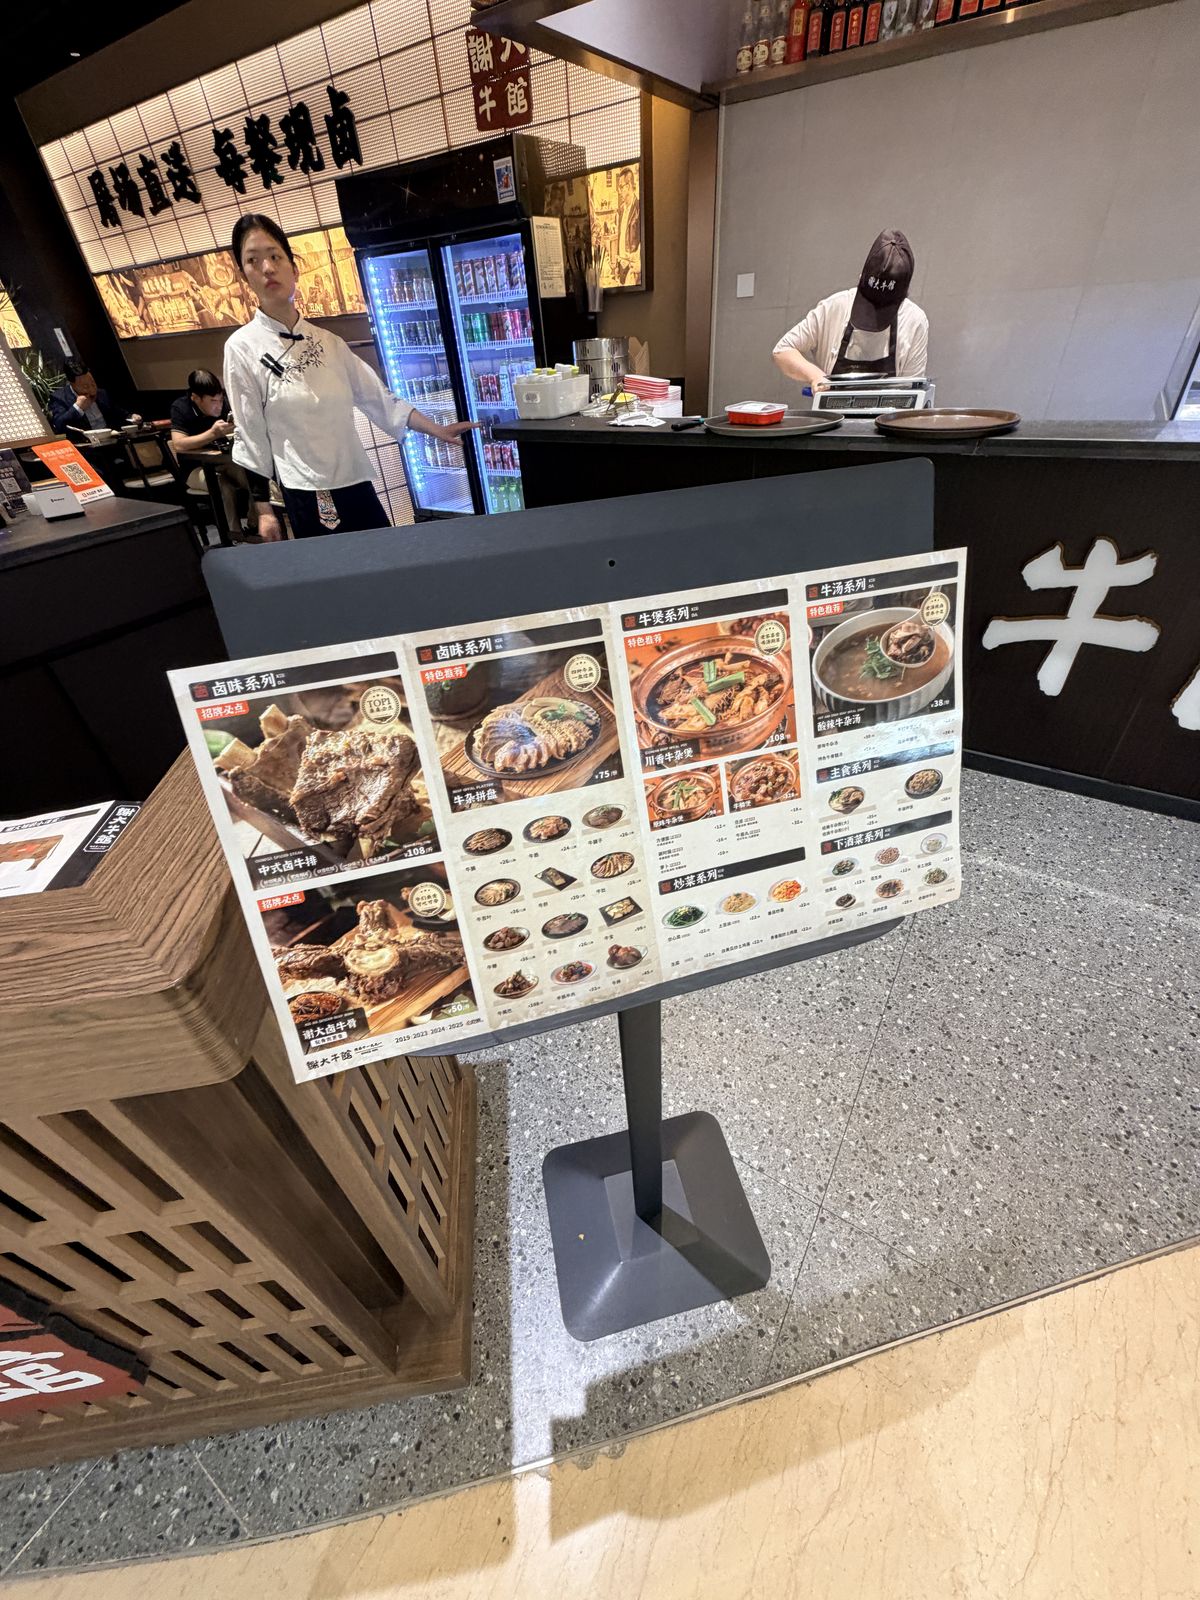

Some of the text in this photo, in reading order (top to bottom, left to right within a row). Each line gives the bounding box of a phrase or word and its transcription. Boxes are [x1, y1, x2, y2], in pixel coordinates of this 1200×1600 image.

[820, 577, 866, 597] 牛汤系列
[638, 606, 689, 627] 牛煲系列
[809, 603, 839, 617] 特色推荐
[435, 637, 492, 660] 卤味系列
[627, 633, 662, 648] 特色推荐
[424, 666, 464, 682] 特色推荐
[210, 672, 277, 697] 卤味系列
[199, 702, 246, 719] 招牌必点
[366, 696, 390, 708] TOP1
[817, 713, 860, 732] 酸辣牛杂汤
[644, 747, 693, 767] 川香牛杂煲
[830, 759, 871, 778] 主食系列
[453, 788, 497, 806] 牛杂拼盘
[835, 828, 883, 850] 下酒菜系列
[257, 854, 318, 876] 中式卤牛排
[673, 868, 717, 890] 炒菜系列
[260, 892, 302, 909] 招牌必点
[301, 1018, 357, 1040] 谢大卤牛骨
[430, 1025, 445, 1034] 2024
[447, 1020, 463, 1029] 2025
